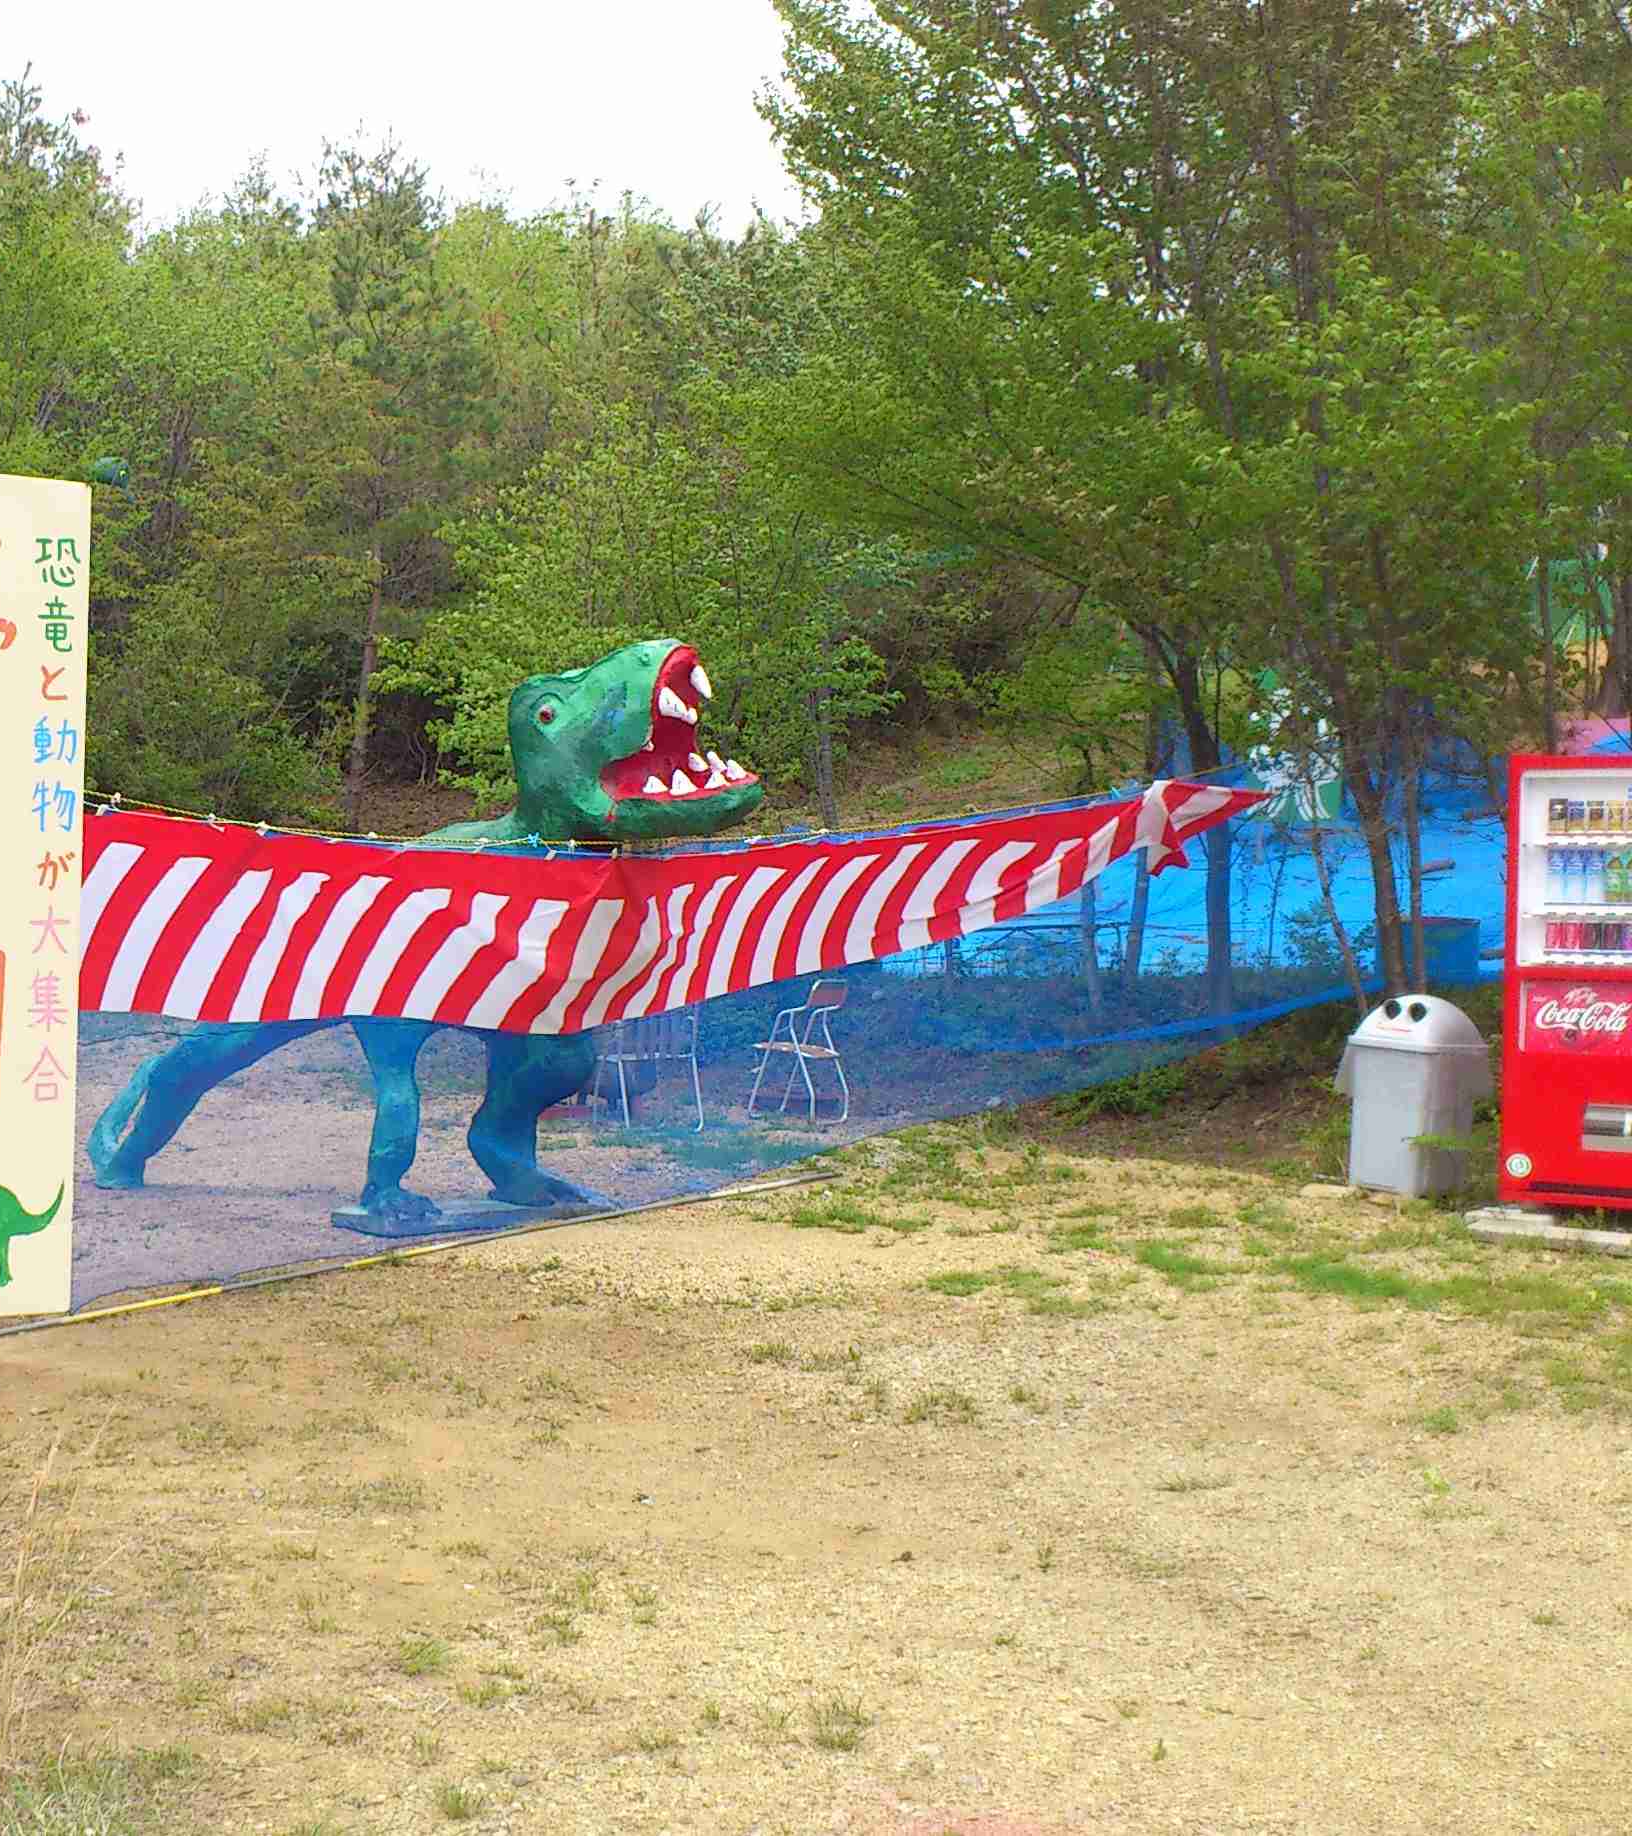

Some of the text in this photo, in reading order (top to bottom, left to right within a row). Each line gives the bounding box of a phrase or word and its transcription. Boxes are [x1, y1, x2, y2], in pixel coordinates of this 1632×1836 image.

[22, 535, 82, 1103] 恐竜と動物が大集合
